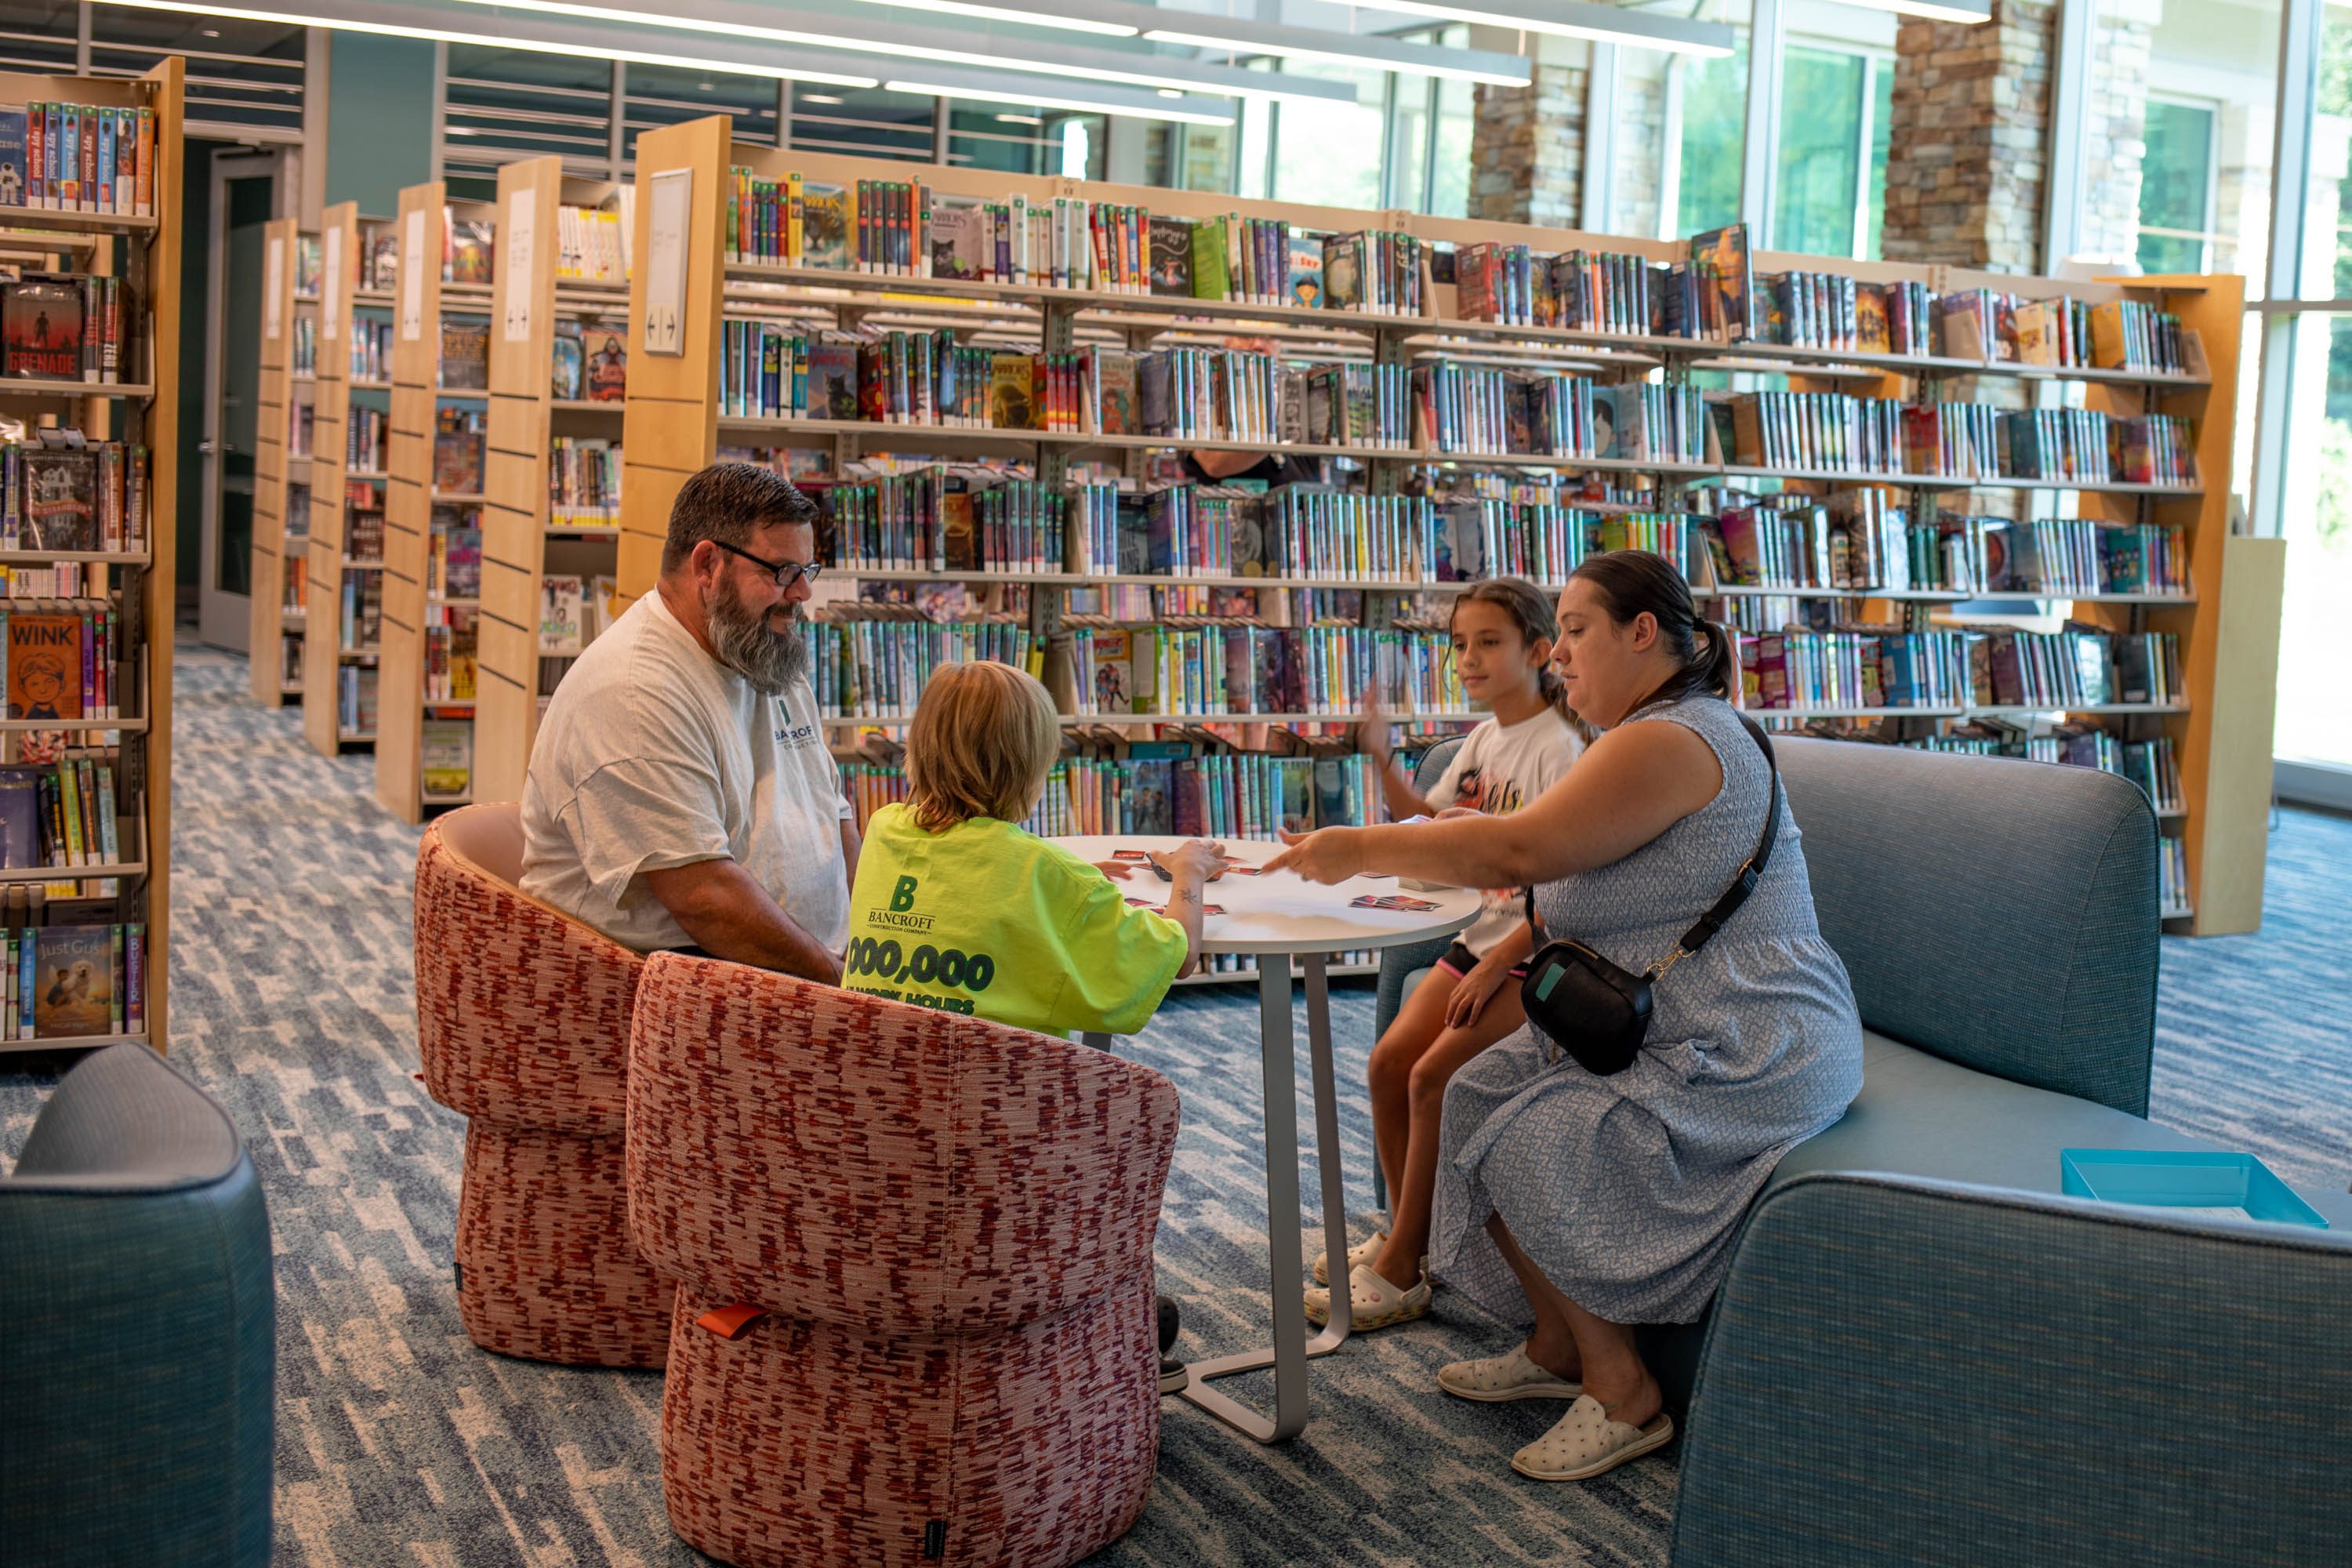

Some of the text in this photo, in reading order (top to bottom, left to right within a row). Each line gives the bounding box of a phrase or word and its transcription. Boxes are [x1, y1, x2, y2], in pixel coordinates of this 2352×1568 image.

[32, 131, 41, 147] spy
[47, 132, 57, 179] spy school
[66, 134, 76, 180] spy school
[84, 135, 94, 182] spy school
[102, 138, 111, 184] spy school
[8, 351, 76, 374] GRENADE
[103, 343, 117, 367] ZERO
[11, 624, 74, 646] WINK
[889, 874, 918, 913] B
[869, 911, 935, 930] BANCROFT
[71, 940, 100, 955] Gus
[130, 938, 140, 1002] BUSTER
[906, 993, 975, 1016] HOURS
